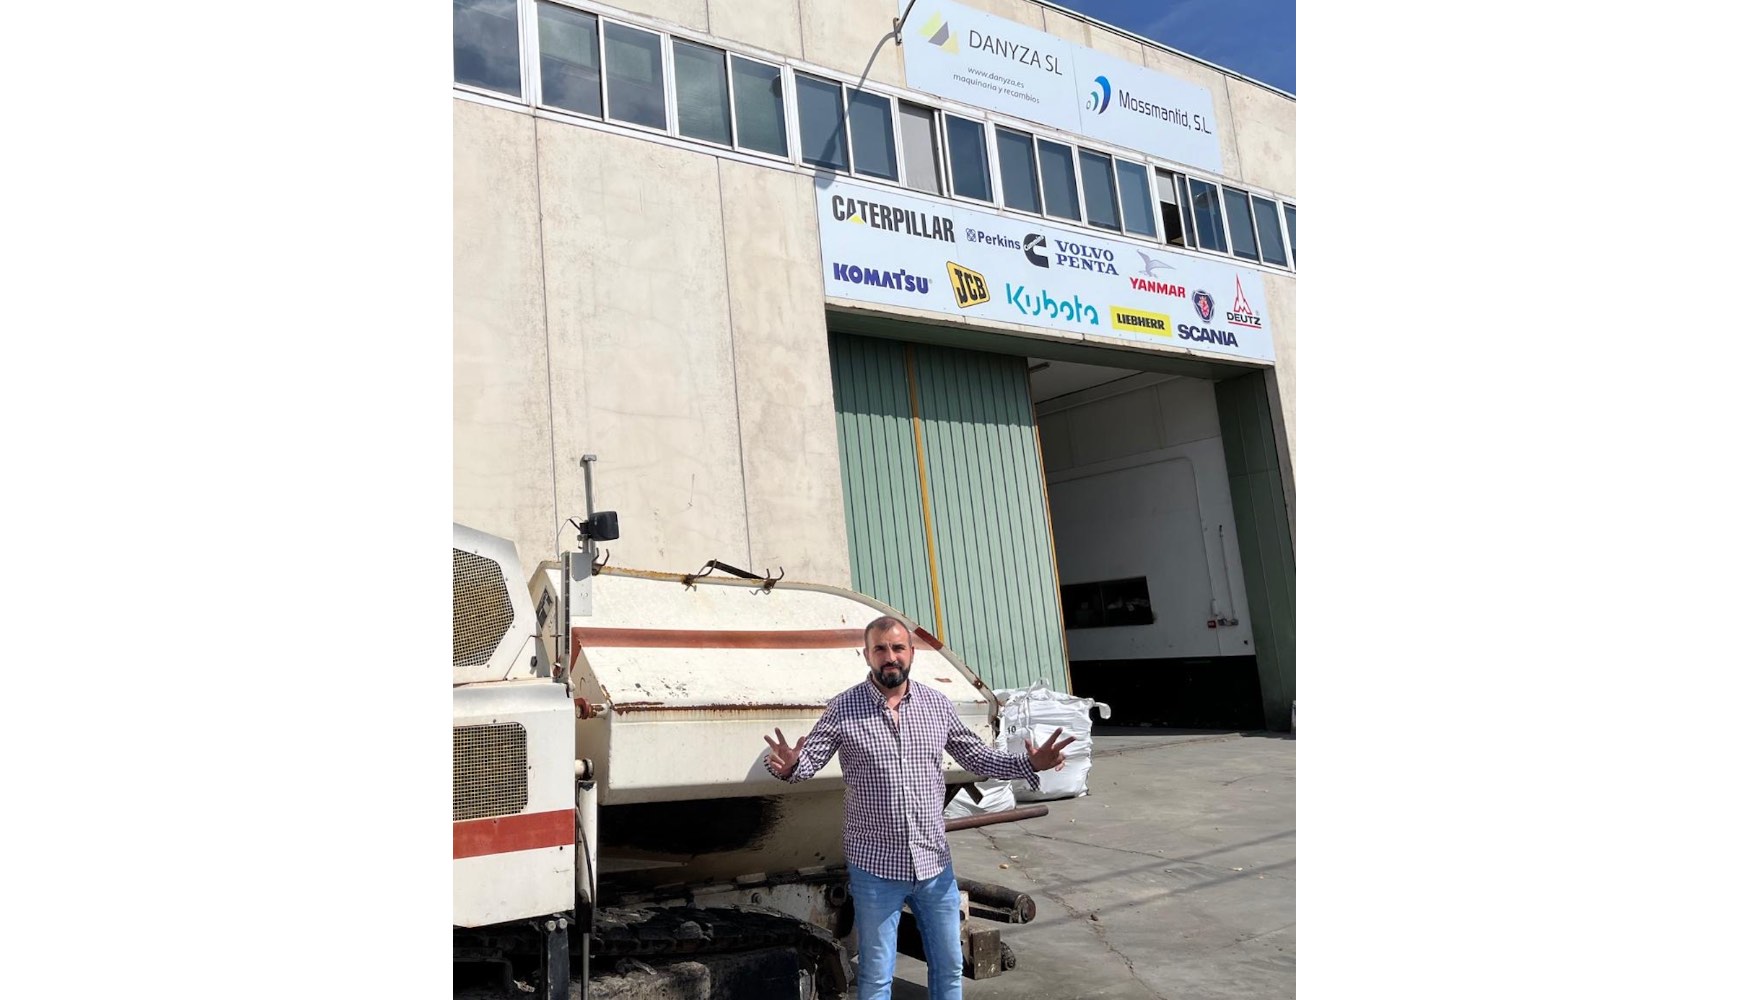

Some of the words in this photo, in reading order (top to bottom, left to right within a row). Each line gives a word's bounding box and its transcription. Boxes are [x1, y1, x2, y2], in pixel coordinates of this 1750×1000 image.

[968, 29, 1042, 70] DANYZA
[1045, 54, 1064, 76] SL
[953, 73, 998, 91] maquinaria
[1003, 87, 1040, 103] recambios
[967, 66, 1025, 88] www.danyza.es
[1118, 89, 1192, 130] Mossmantid,
[1194, 114, 1213, 135] S.L.
[832, 195, 956, 243] CATERPILLAR
[978, 230, 1022, 251] Perkins
[1055, 239, 1115, 262] VOLVO
[1056, 253, 1120, 276] PENTA
[833, 262, 930, 295] KOMATSU
[953, 268, 987, 304] JCB
[1129, 276, 1187, 299] YANMAR
[1005, 282, 1100, 326] Kubota
[1116, 313, 1166, 331] LIEBHERR
[1226, 311, 1262, 326] DEUTZ
[1177, 323, 1239, 348] SCANIA
[1007, 725, 1017, 734] 10
